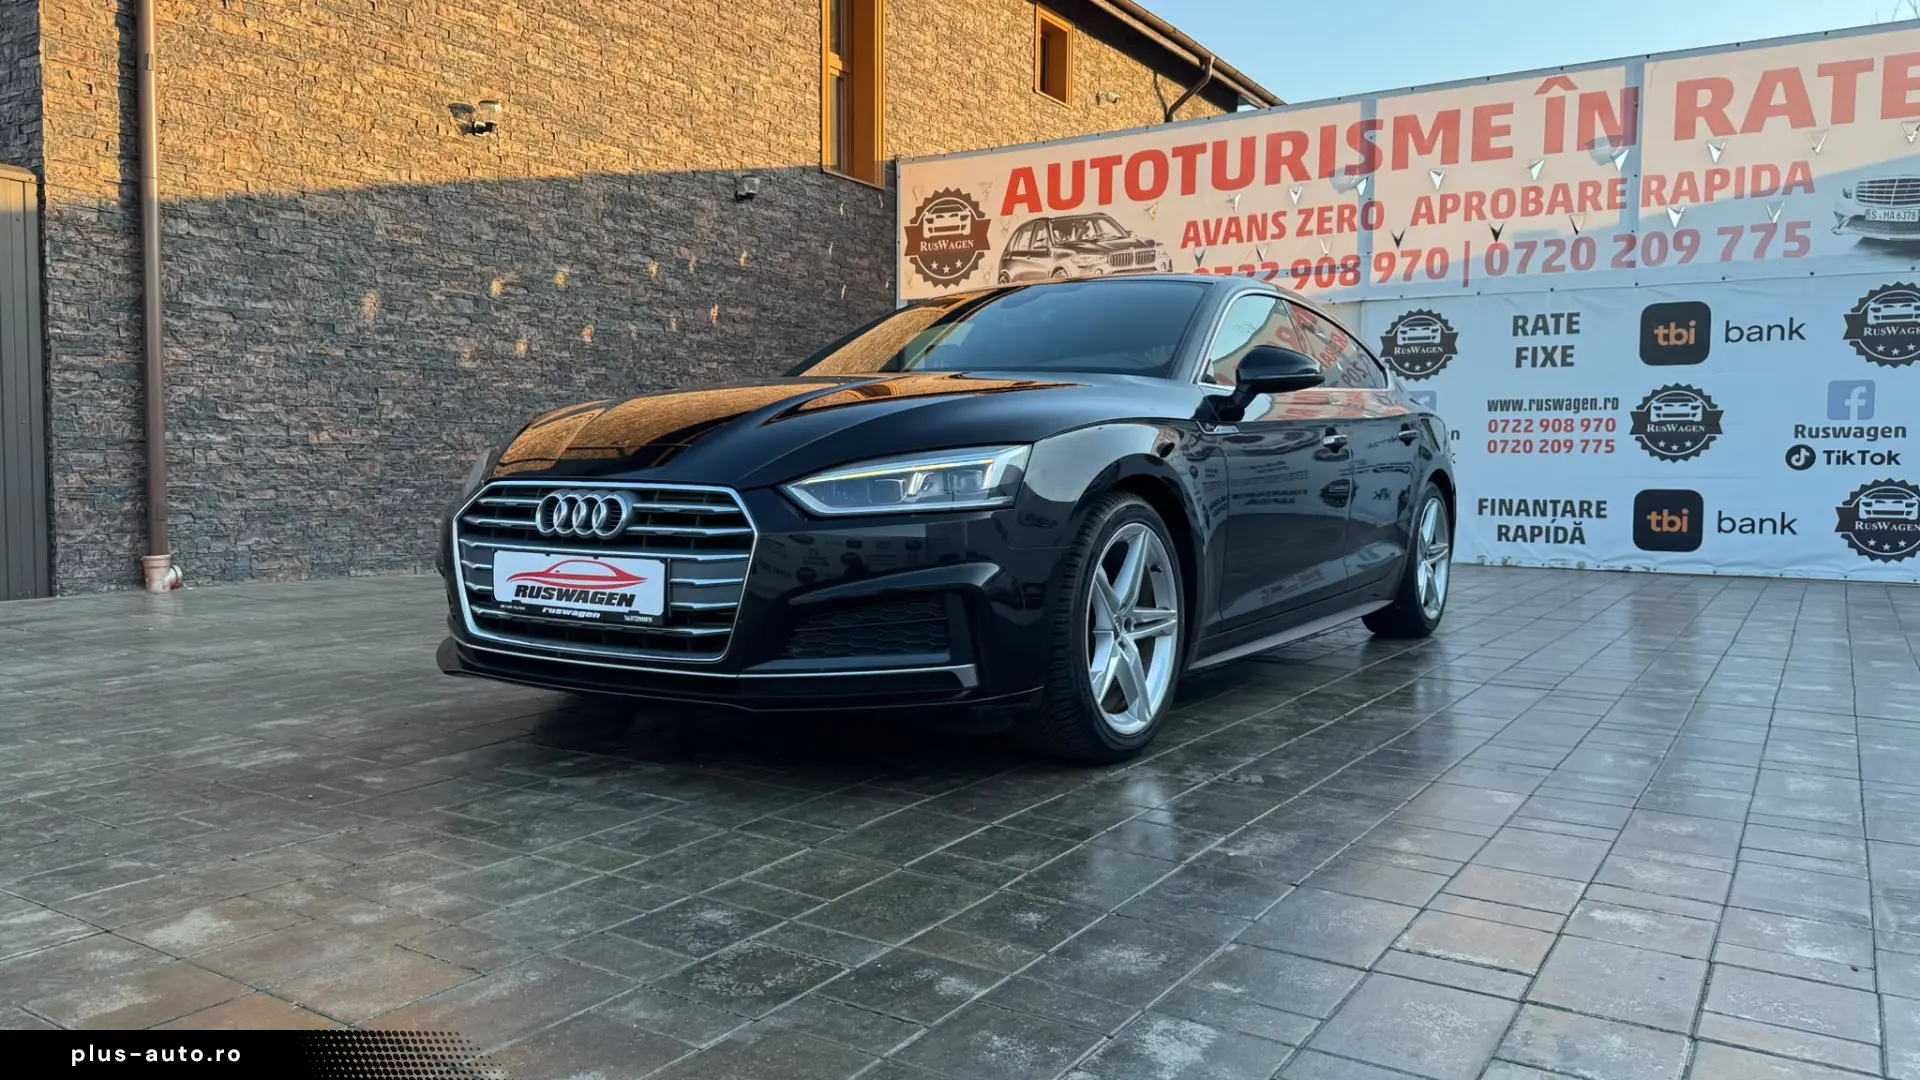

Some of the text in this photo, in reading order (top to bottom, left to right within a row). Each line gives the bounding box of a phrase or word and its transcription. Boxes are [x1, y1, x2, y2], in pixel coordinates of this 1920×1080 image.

[1000, 51, 1920, 216] AUTOTURISME ÎN RATE
[1180, 160, 1816, 249] AVANS ZERO APROBARE RAPIDA
[1290, 254, 1361, 290] 908
[1373, 246, 1450, 284] 970
[1484, 237, 1597, 276] 0720
[1611, 229, 1701, 269] 209
[1716, 220, 1812, 262] 775
[1512, 312, 1581, 337] RATE
[1653, 316, 1807, 346] tbi bank
[1515, 344, 1575, 368] FIXE
[1487, 397, 1620, 414] www.ruswagen.ro
[1488, 417, 1617, 434] 0722 908 970
[1793, 423, 1908, 442] Ruswagen
[1487, 439, 1616, 454] 0720 209 775
[1822, 449, 1902, 466] TikTok
[1646, 508, 1799, 536] tbi bank
[514, 584, 636, 608] RUSWAGEN
[542, 606, 601, 619] ruswagen
